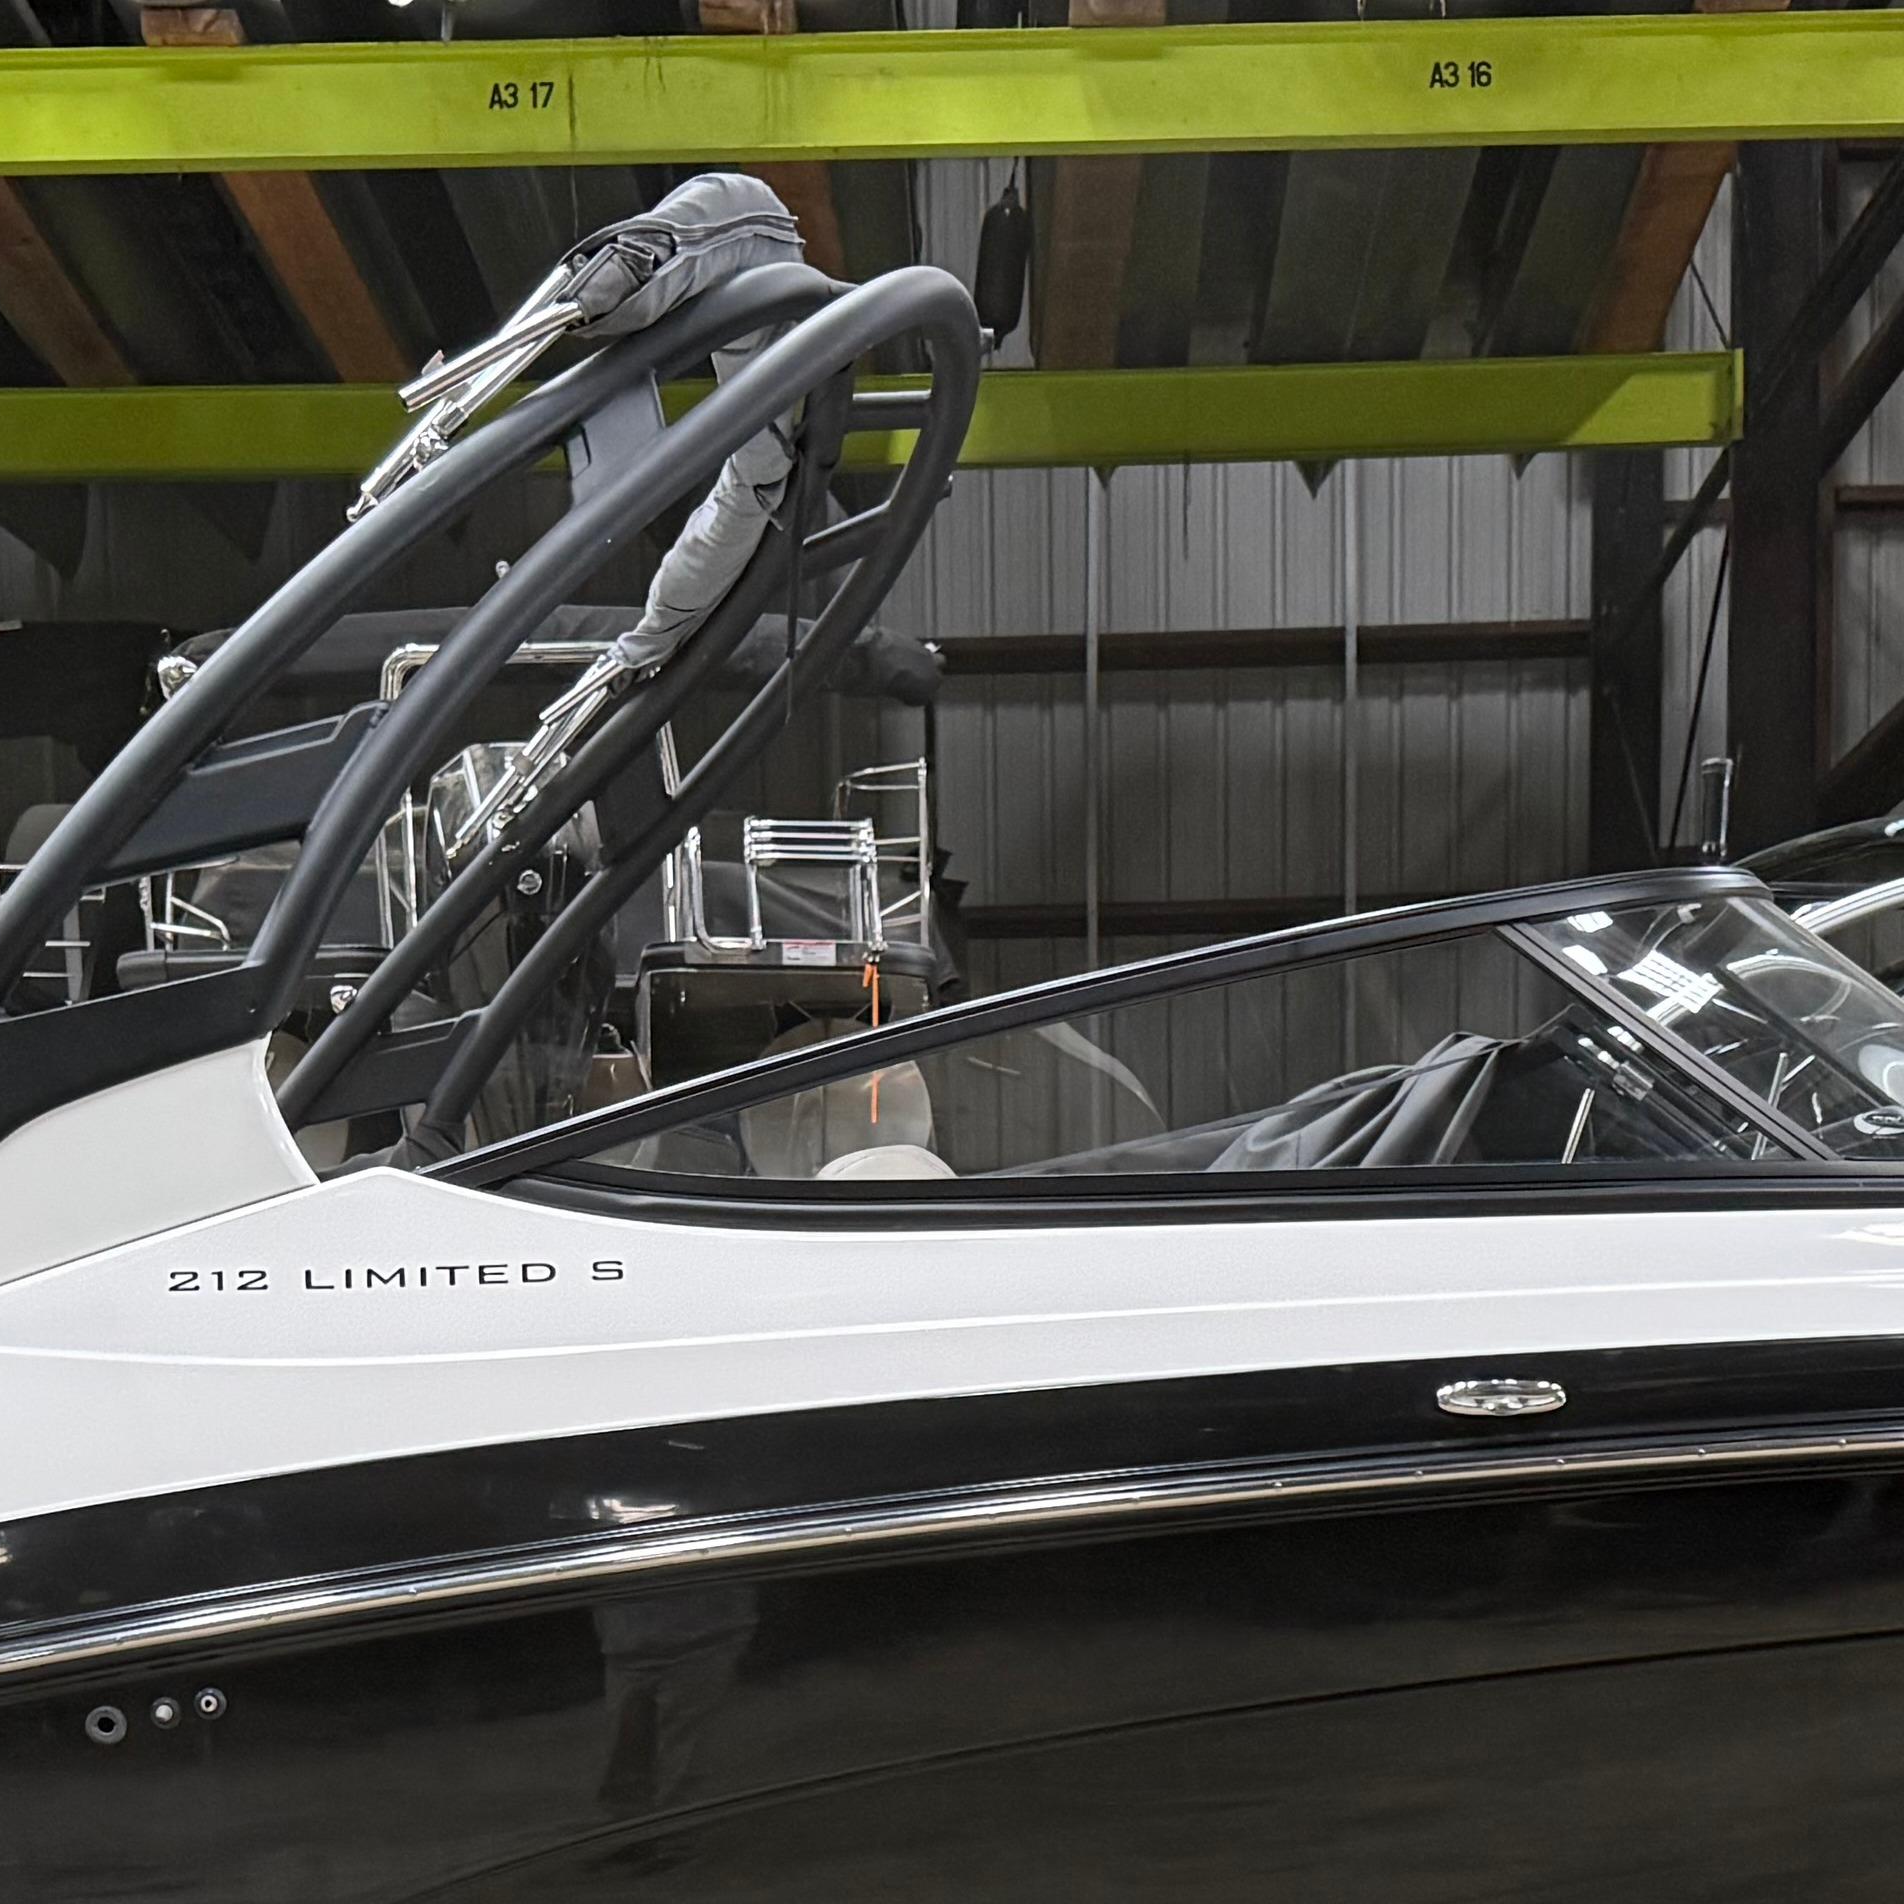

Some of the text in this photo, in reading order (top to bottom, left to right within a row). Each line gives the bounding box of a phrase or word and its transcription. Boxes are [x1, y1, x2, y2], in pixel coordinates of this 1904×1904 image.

[1429, 61, 1492, 89] A3 16
[488, 81, 555, 109] A3 17
[168, 1259, 625, 1292] 212 LIMITED S
